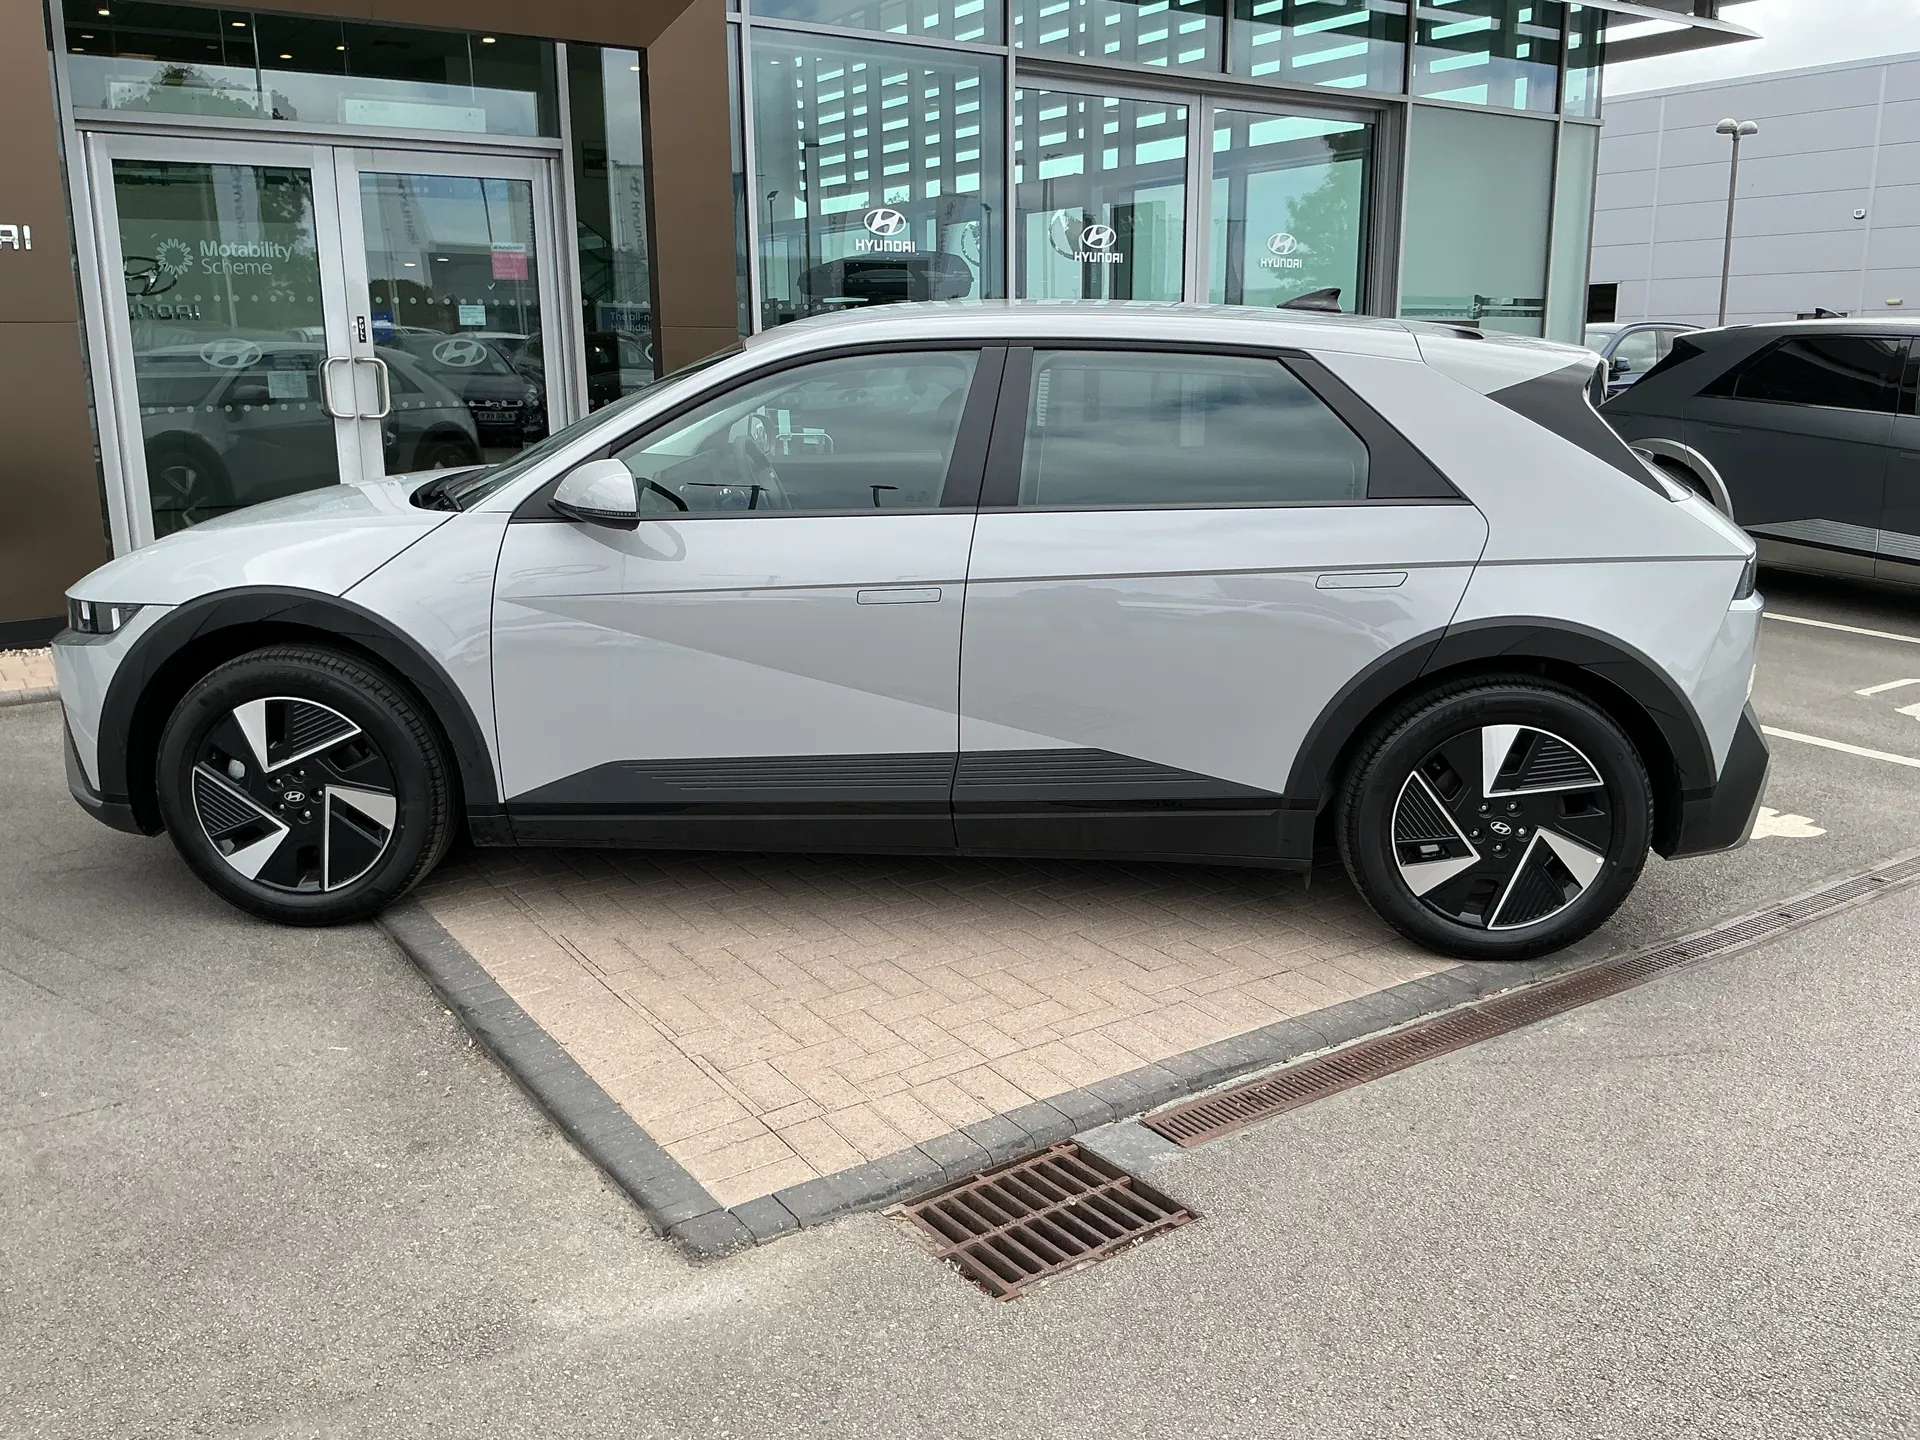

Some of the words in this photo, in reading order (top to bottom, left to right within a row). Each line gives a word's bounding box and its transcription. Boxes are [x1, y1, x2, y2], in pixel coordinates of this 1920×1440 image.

[200, 240, 292, 263] Motability
[855, 239, 916, 253] HYUNDAI
[1074, 251, 1123, 264] HYUNDAI
[1260, 258, 1302, 269] HYUNDAI
[201, 258, 273, 276] Scheme
[358, 317, 366, 341] PULL
